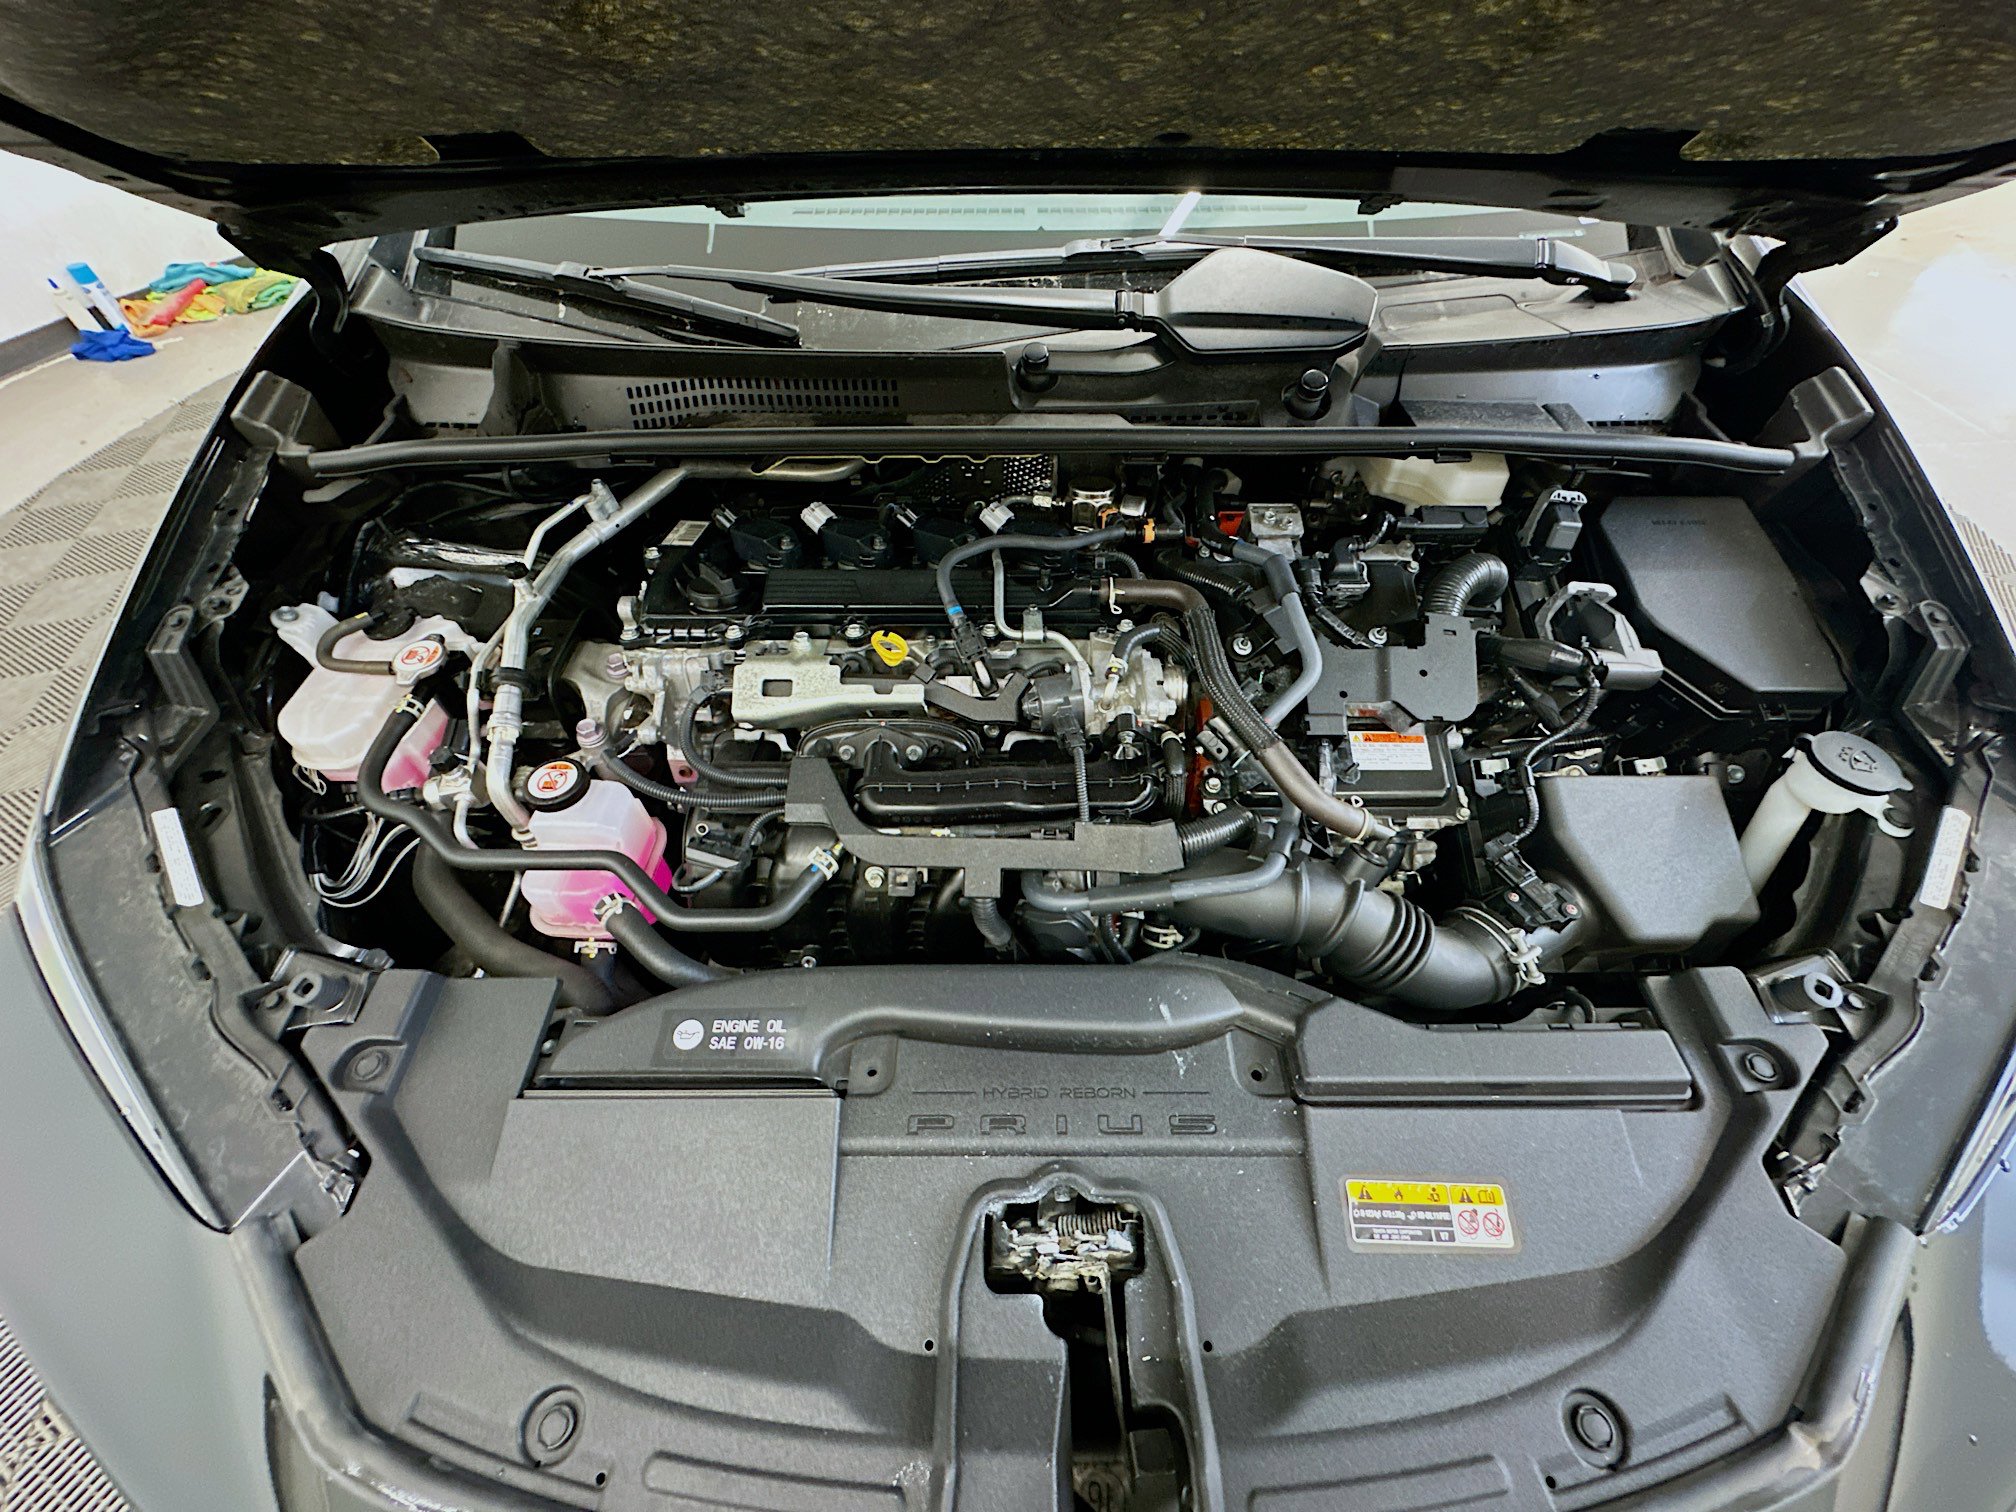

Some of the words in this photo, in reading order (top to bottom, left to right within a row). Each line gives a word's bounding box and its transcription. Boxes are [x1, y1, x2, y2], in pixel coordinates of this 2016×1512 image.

[711, 1019, 760, 1033] ENGINE
[766, 1019, 787, 1033] OIL
[708, 1036, 738, 1050] SAE
[743, 1036, 785, 1050] 0W-16
[982, 1086, 1049, 1099] HYBRID
[1060, 1086, 1137, 1100] REBORN
[905, 1113, 1218, 1136] PRIUS
